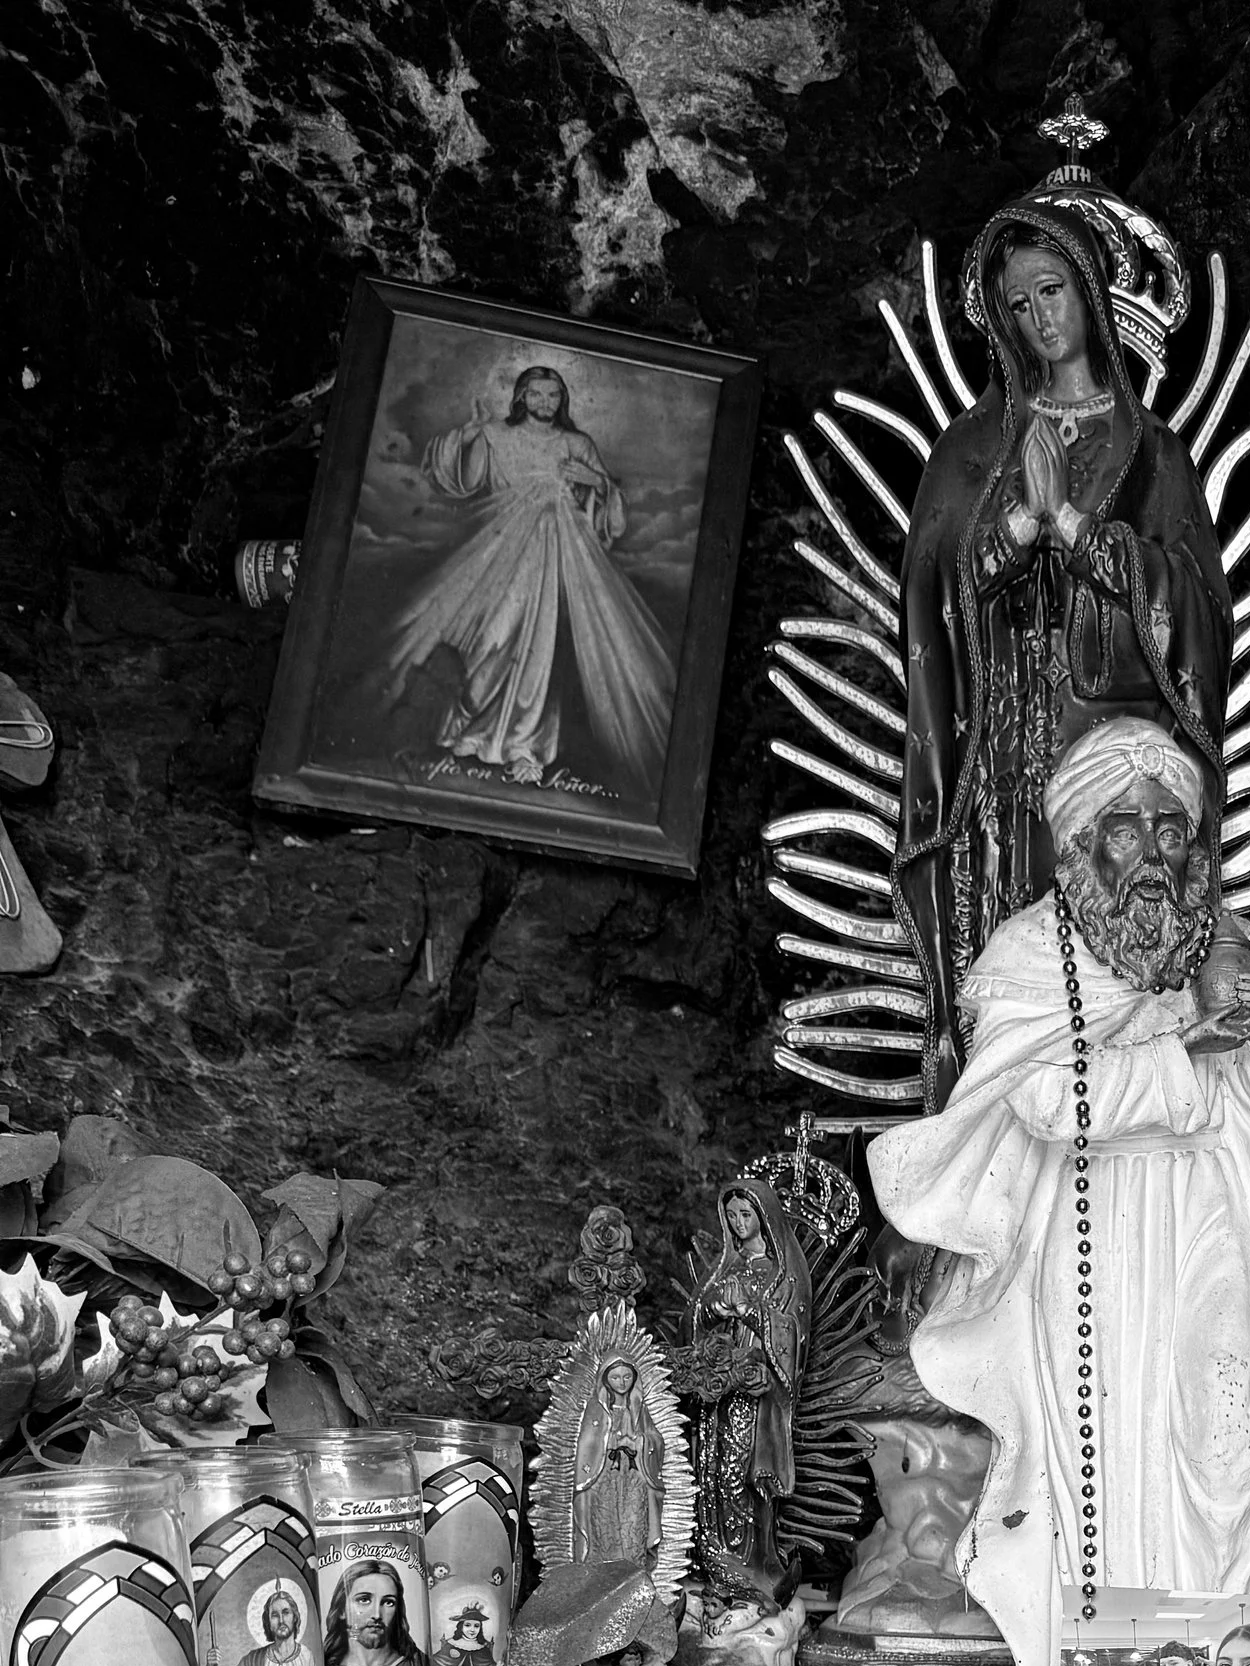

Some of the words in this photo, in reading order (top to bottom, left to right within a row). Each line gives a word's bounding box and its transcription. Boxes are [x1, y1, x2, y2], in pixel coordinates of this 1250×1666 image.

[339, 1502, 383, 1516] Stella
[345, 1542, 397, 1560] Corazón
[397, 1545, 410, 1562] de
